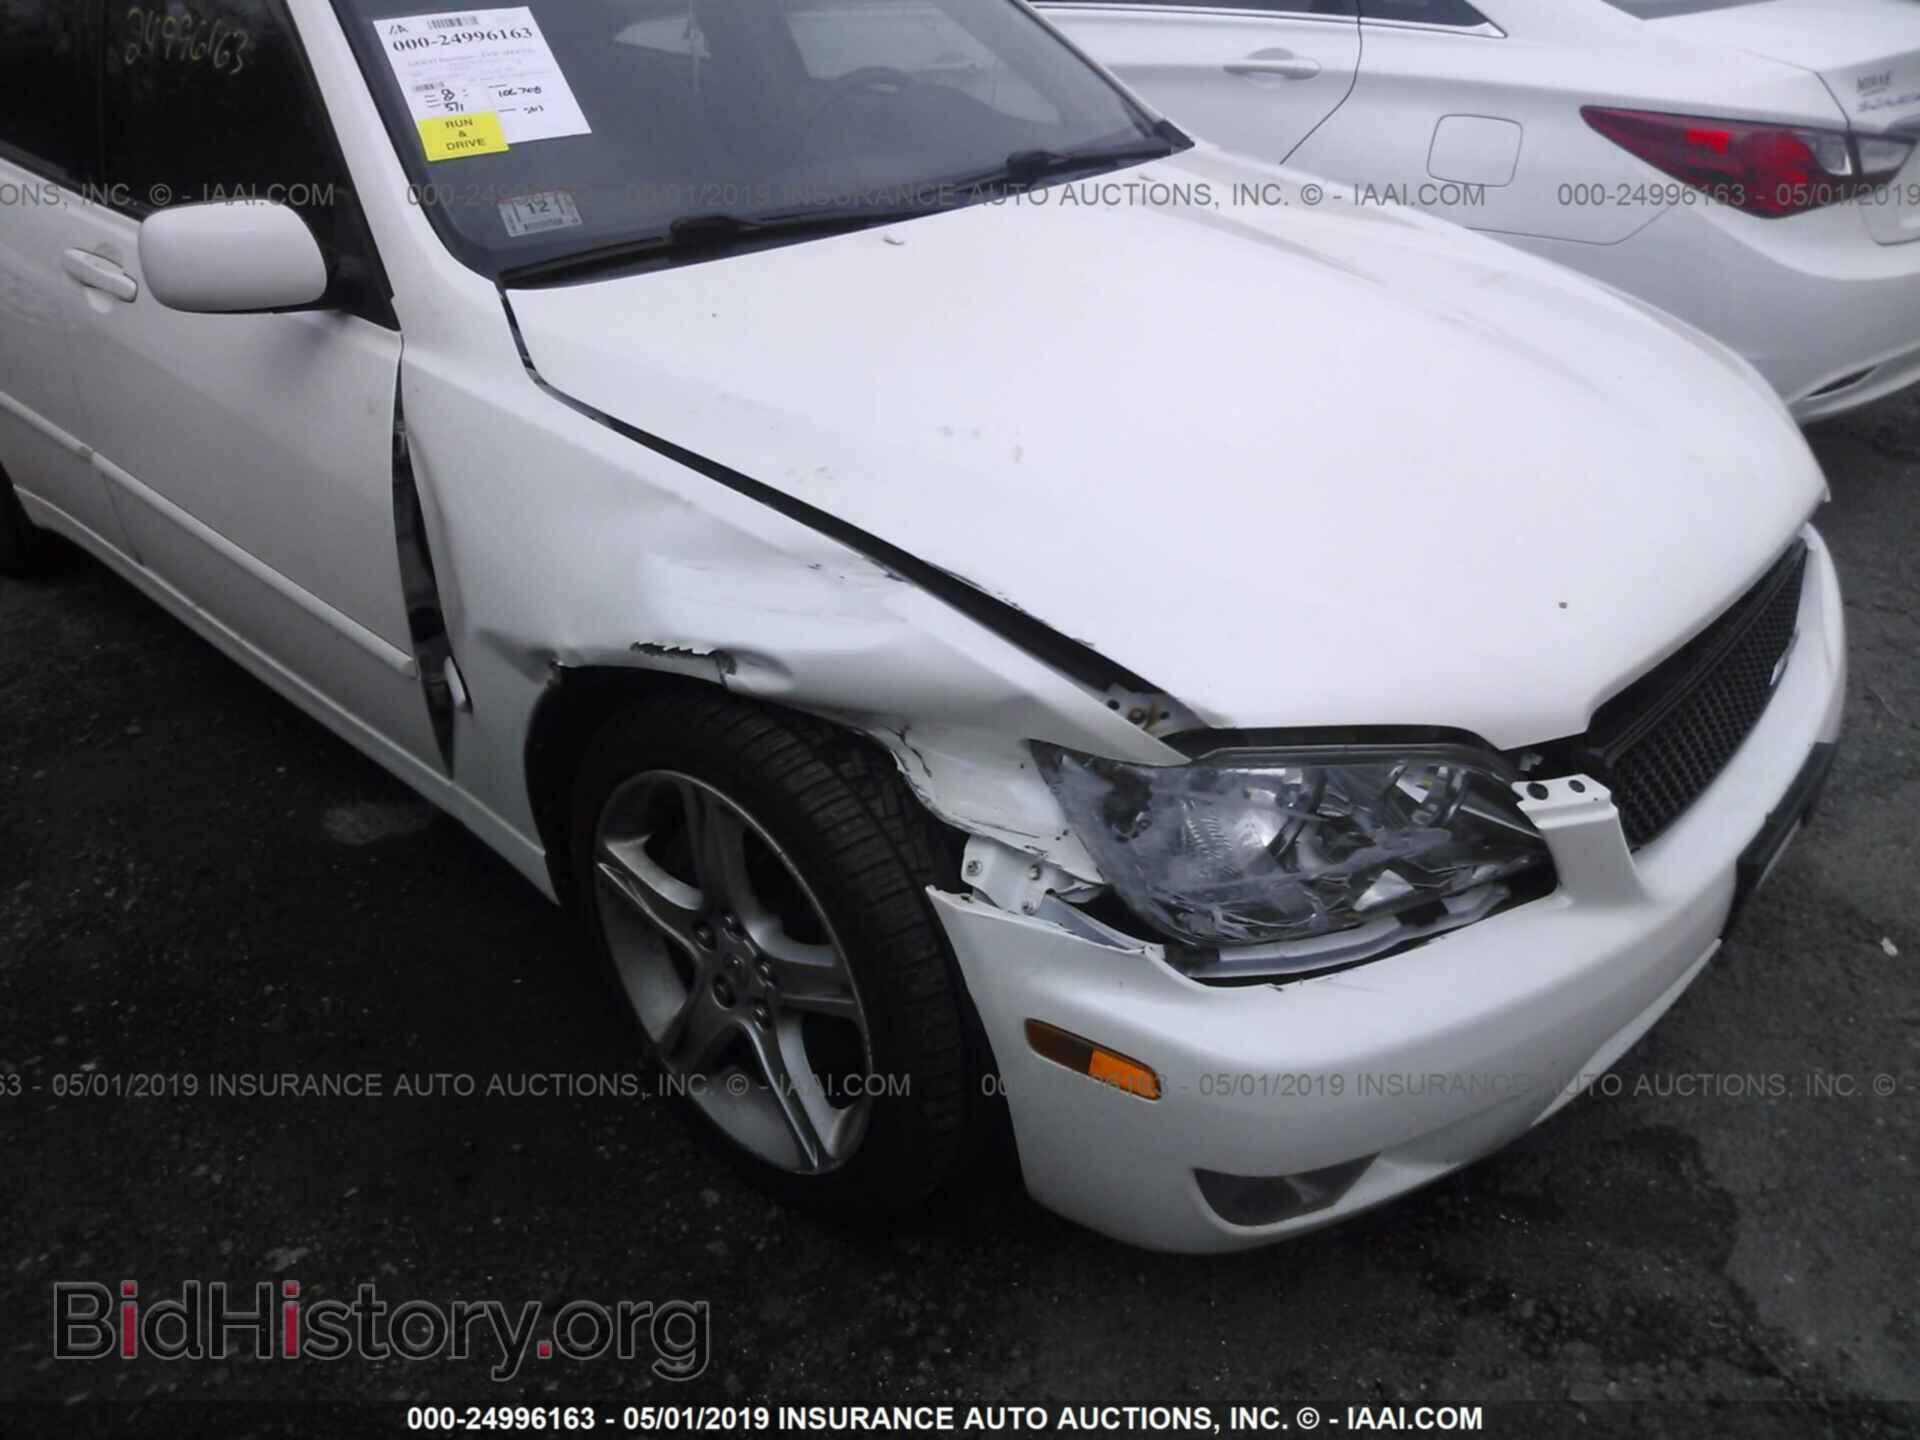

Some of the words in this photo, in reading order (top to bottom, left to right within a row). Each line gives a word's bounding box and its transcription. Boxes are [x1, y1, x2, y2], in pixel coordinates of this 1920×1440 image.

[392, 27, 533, 51] 000-24996163
[445, 118, 474, 128] RUN
[458, 130, 467, 138] &
[446, 138, 486, 151] DRIVE
[526, 201, 551, 215] 12
